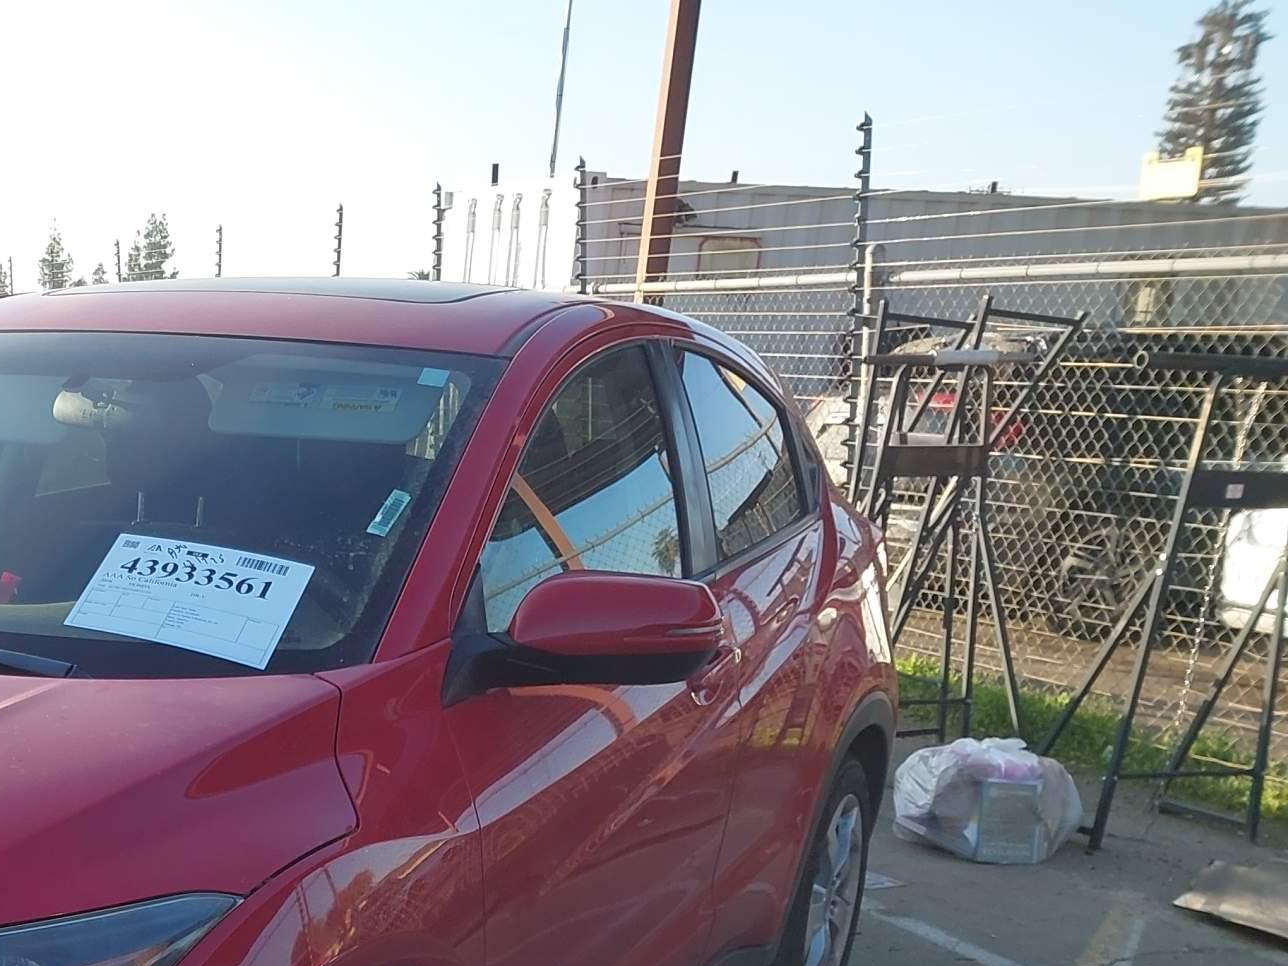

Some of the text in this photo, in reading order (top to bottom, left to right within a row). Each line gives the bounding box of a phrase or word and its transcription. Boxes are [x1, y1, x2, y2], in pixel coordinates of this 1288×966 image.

[103, 572, 123, 580] AAA
[138, 577, 178, 588] California
[120, 557, 273, 601] 43933561
